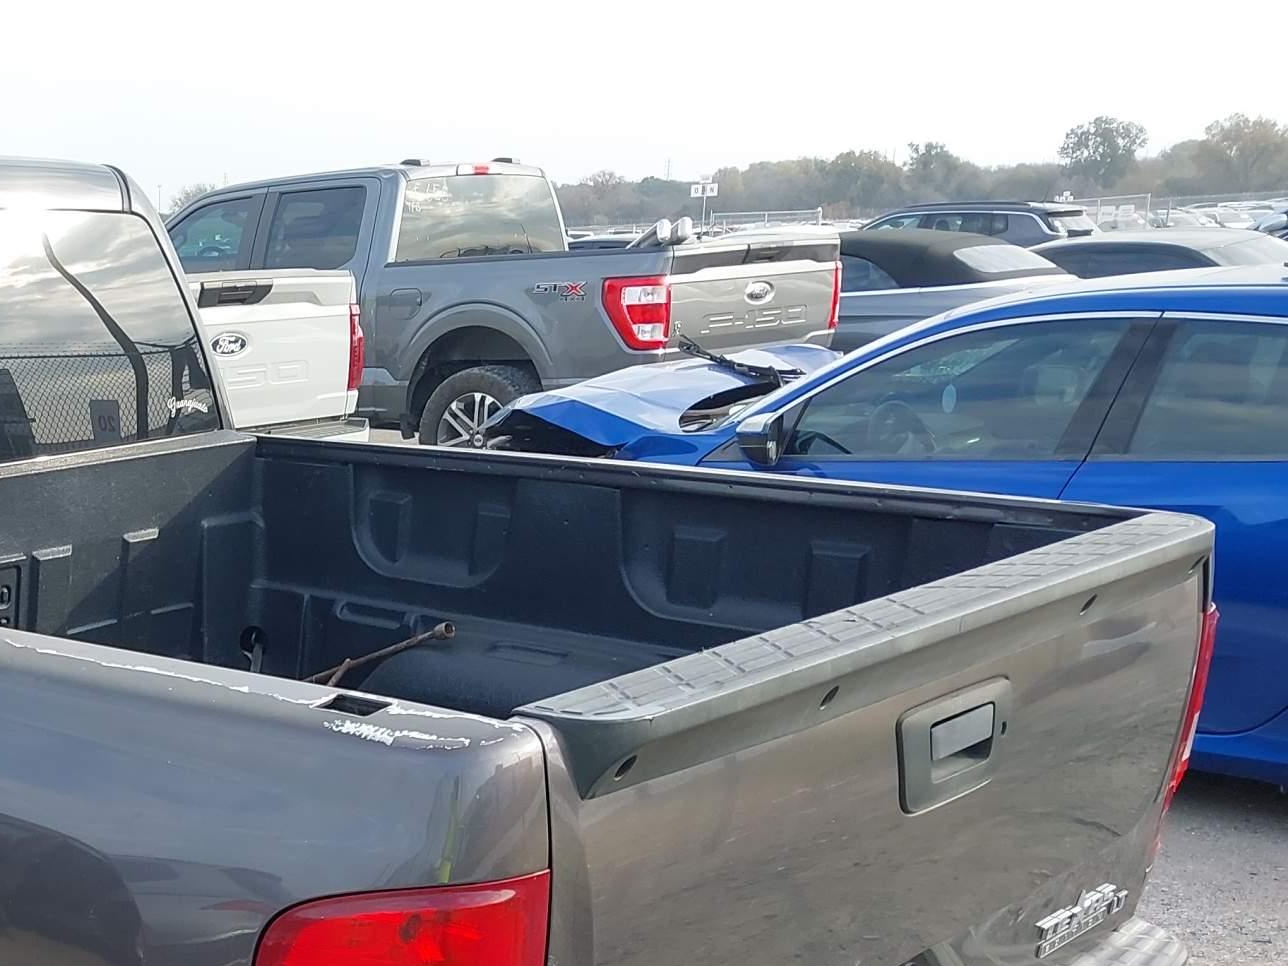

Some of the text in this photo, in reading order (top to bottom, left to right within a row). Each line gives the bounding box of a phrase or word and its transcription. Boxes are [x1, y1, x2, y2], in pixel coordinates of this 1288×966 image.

[533, 281, 587, 296] STX
[700, 305, 807, 333] F-150
[216, 336, 242, 353] Ford
